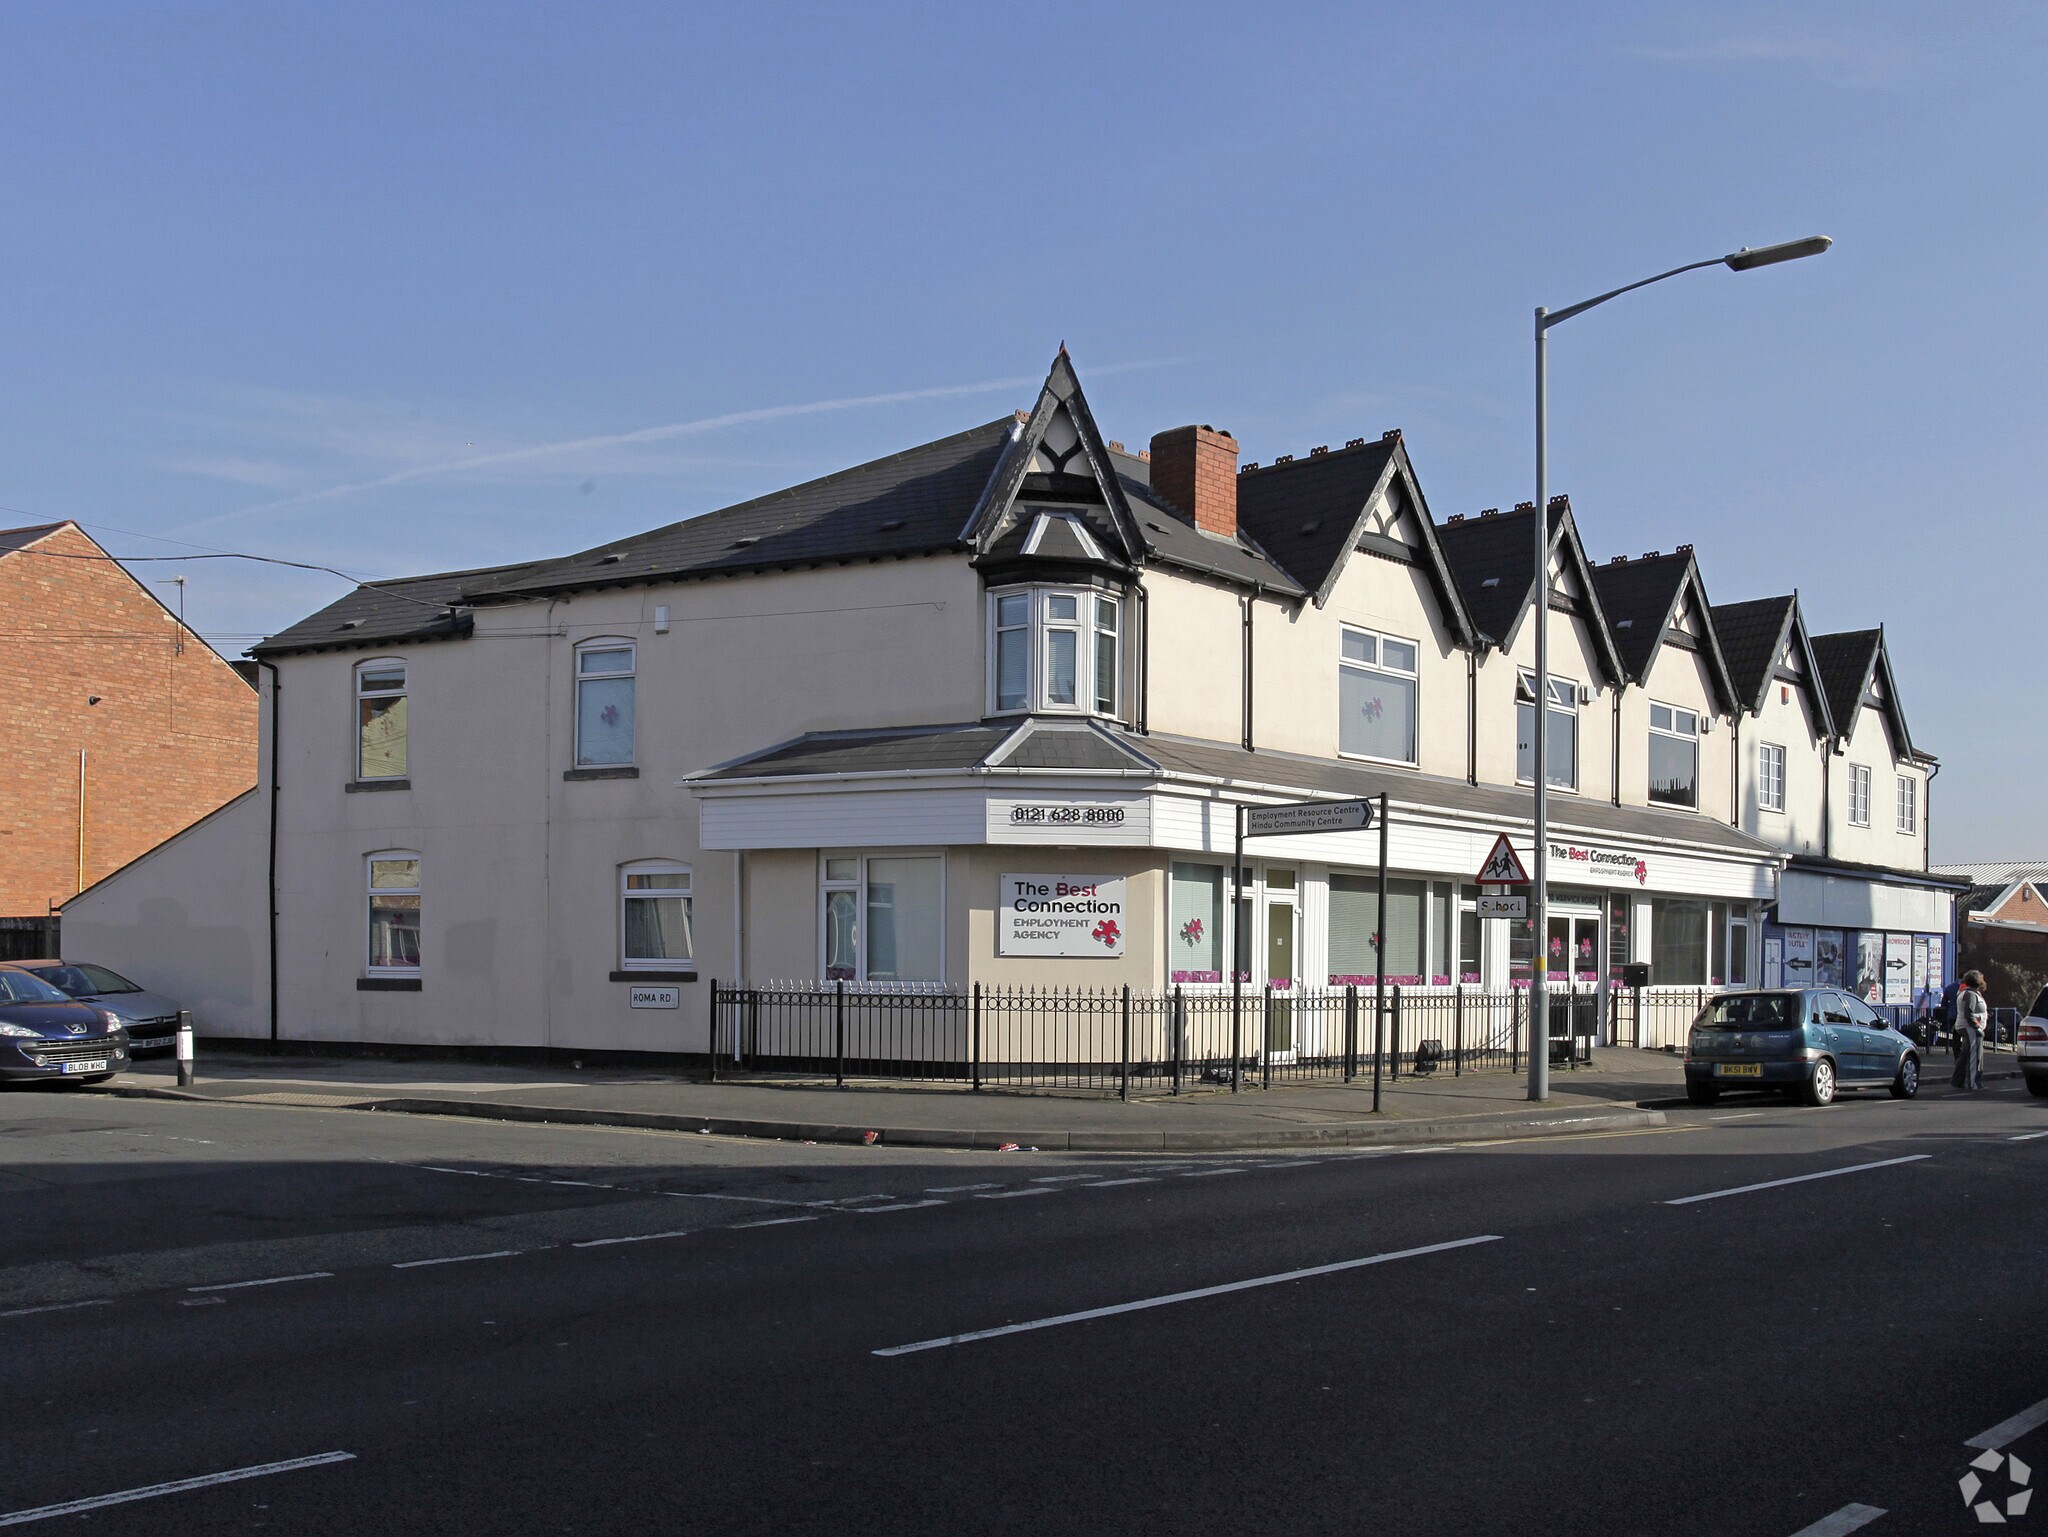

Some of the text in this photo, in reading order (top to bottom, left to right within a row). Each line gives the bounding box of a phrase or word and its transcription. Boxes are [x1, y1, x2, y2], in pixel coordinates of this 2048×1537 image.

[1015, 807, 1125, 822] 0121 628 8000
[1251, 805, 1360, 820] Employment Resource Centre
[1251, 816, 1343, 830] Hindu Community Centre
[1549, 844, 1637, 866] The Best Connection
[1014, 881, 1097, 897] The Best
[1014, 898, 1121, 914] Connection
[1481, 901, 1521, 912] Shool
[1013, 918, 1091, 928] EMPLOYMENT
[1013, 930, 1061, 940] AGENCY
[633, 993, 671, 1002] ROMA RD
[68, 1061, 106, 1072] BL08 WHC
[1723, 1065, 1741, 1074] BK51
